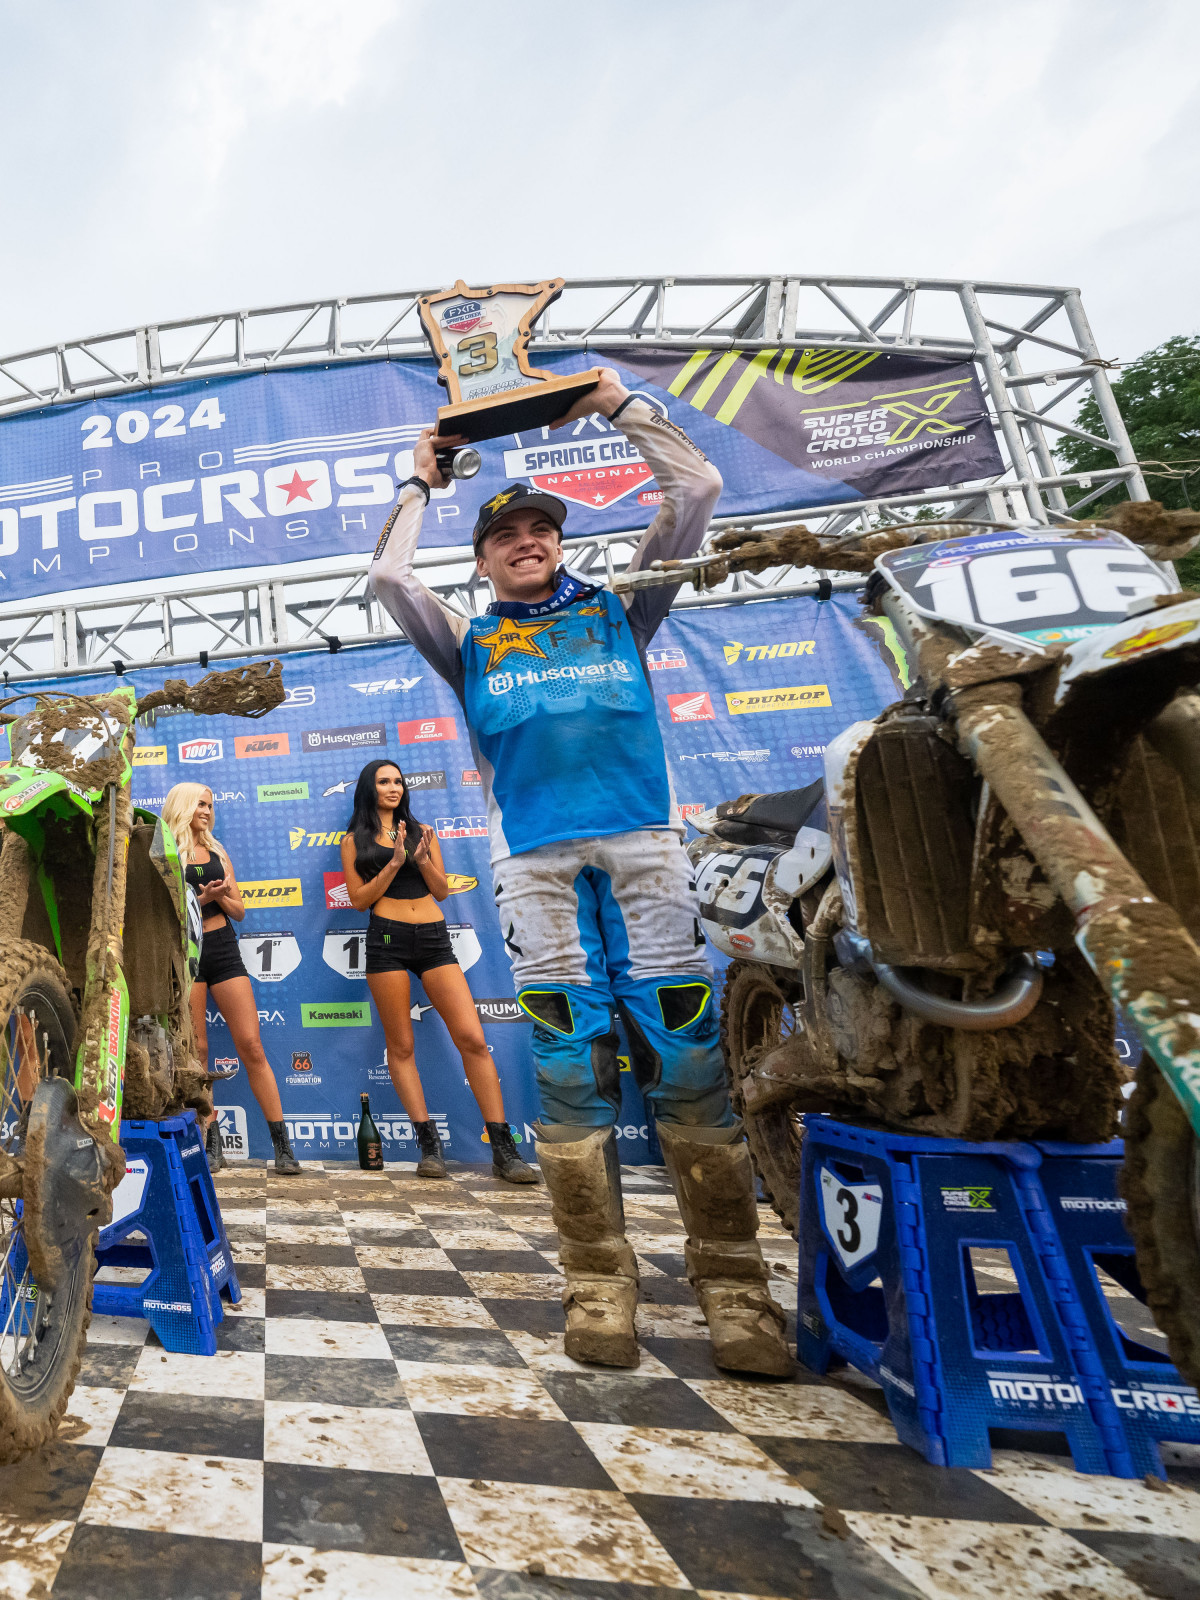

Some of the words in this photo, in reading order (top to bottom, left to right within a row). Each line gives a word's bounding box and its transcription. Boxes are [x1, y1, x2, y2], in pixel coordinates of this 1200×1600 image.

[449, 303, 475, 317] FXR
[457, 332, 498, 376] 3
[81, 397, 226, 451] 2024
[803, 408, 889, 430] SUPER
[811, 420, 887, 441] MOTO
[806, 432, 891, 454] CROSS
[811, 455, 861, 469] WORLD
[864, 434, 976, 461] CHAMPIONSHIP
[525, 445, 596, 471] SPRING
[599, 440, 638, 462] CRE
[82, 450, 223, 487] PRO
[547, 466, 648, 484] NATIONAL
[914, 548, 1170, 625] 166
[529, 582, 575, 615] OAKLEY
[547, 620, 623, 648] FLY
[744, 640, 816, 662] THOR
[516, 659, 629, 686] Husqvarna
[746, 691, 826, 705] DUNLOP
[674, 713, 714, 722] HONDA
[244, 739, 280, 753] KTM
[322, 730, 380, 744] Husqvarna
[132, 750, 165, 759] LOP
[184, 742, 218, 759] 100%
[679, 748, 771, 761] INTENSE
[262, 787, 303, 797] Kawasaki
[437, 816, 488, 831] PAR
[438, 828, 488, 839] UNLIM
[108, 987, 122, 1058] BRAKING
[309, 1010, 363, 1020] Kawasaki
[294, 1058, 311, 1071] 66
[1060, 1200, 1128, 1211] MOTOCR
[836, 1187, 861, 1254] 3
[143, 1301, 192, 1312] MOTOCROSS
[1111, 1388, 1200, 1415] CROS
